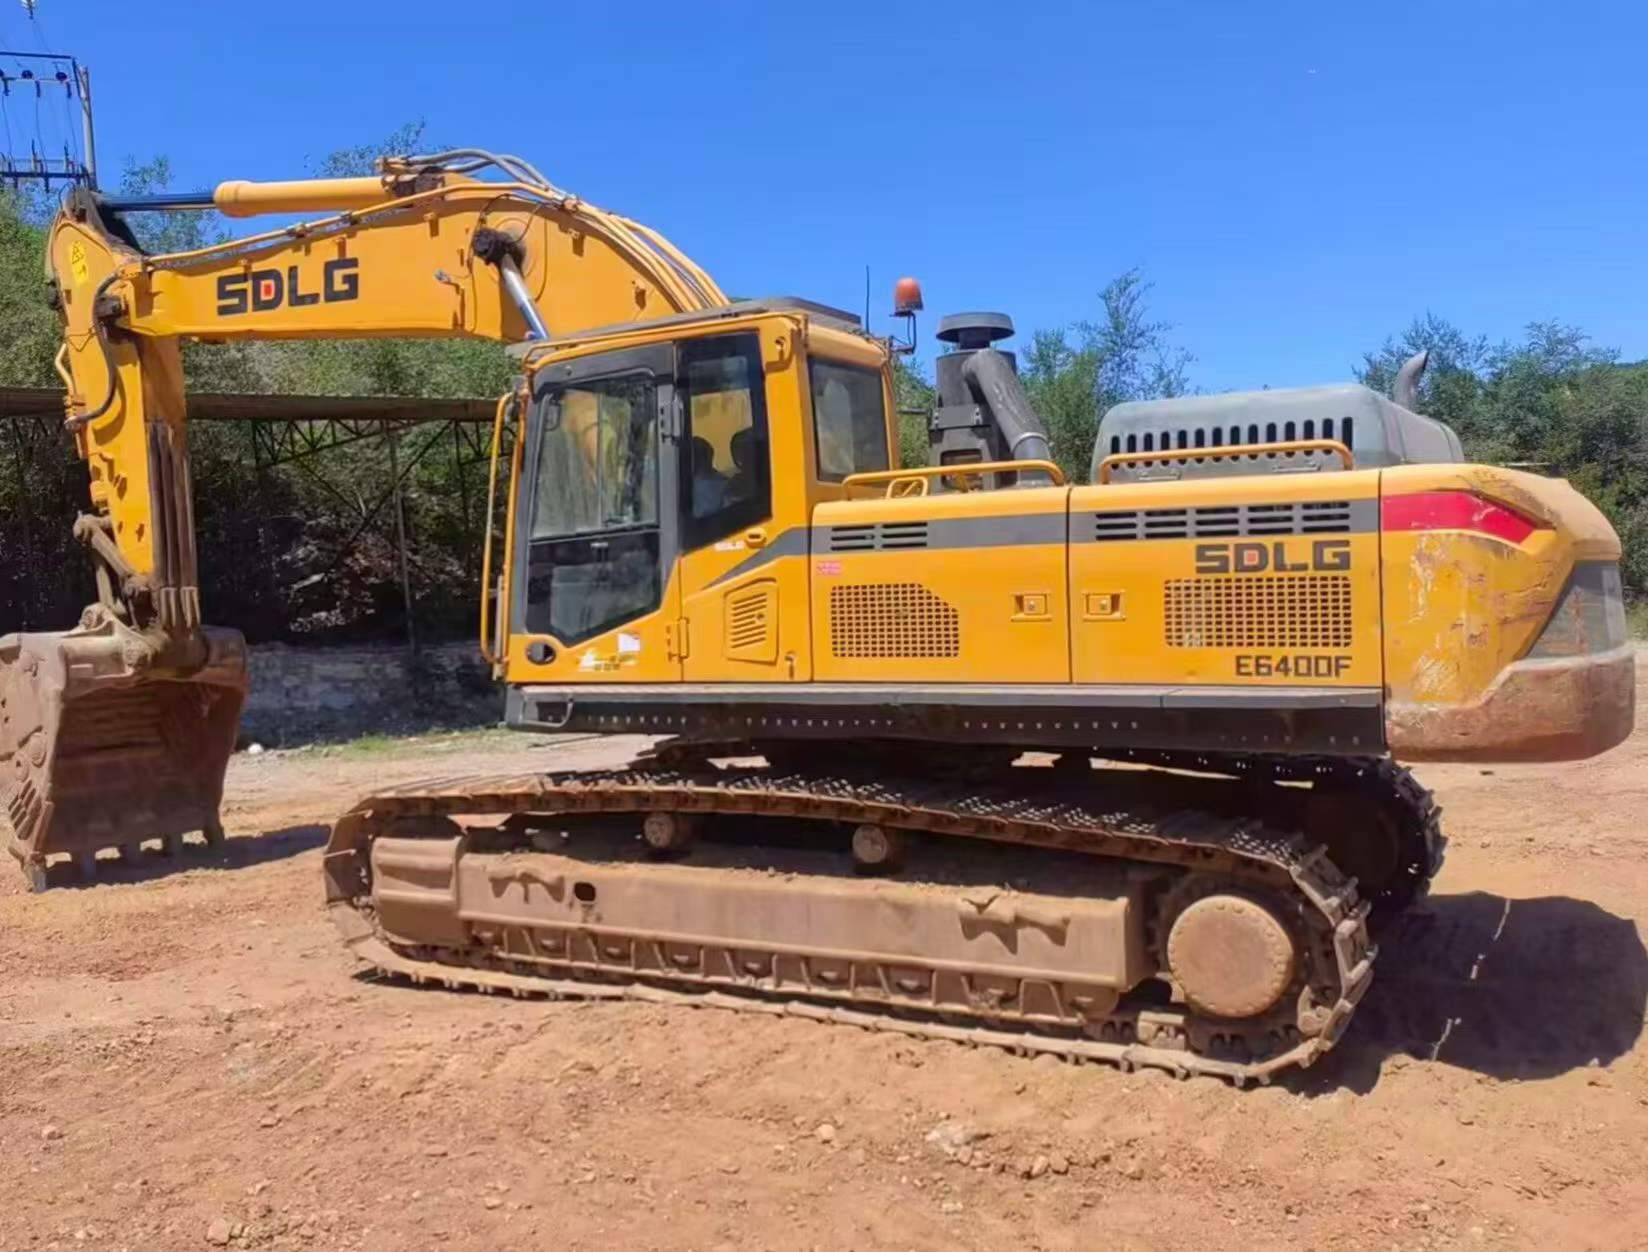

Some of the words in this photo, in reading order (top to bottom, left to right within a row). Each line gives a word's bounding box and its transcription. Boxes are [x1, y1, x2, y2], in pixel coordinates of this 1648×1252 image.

[217, 257, 359, 316] SDLG
[1195, 540, 1351, 574] SDLG
[1235, 655, 1352, 678] E6400F
